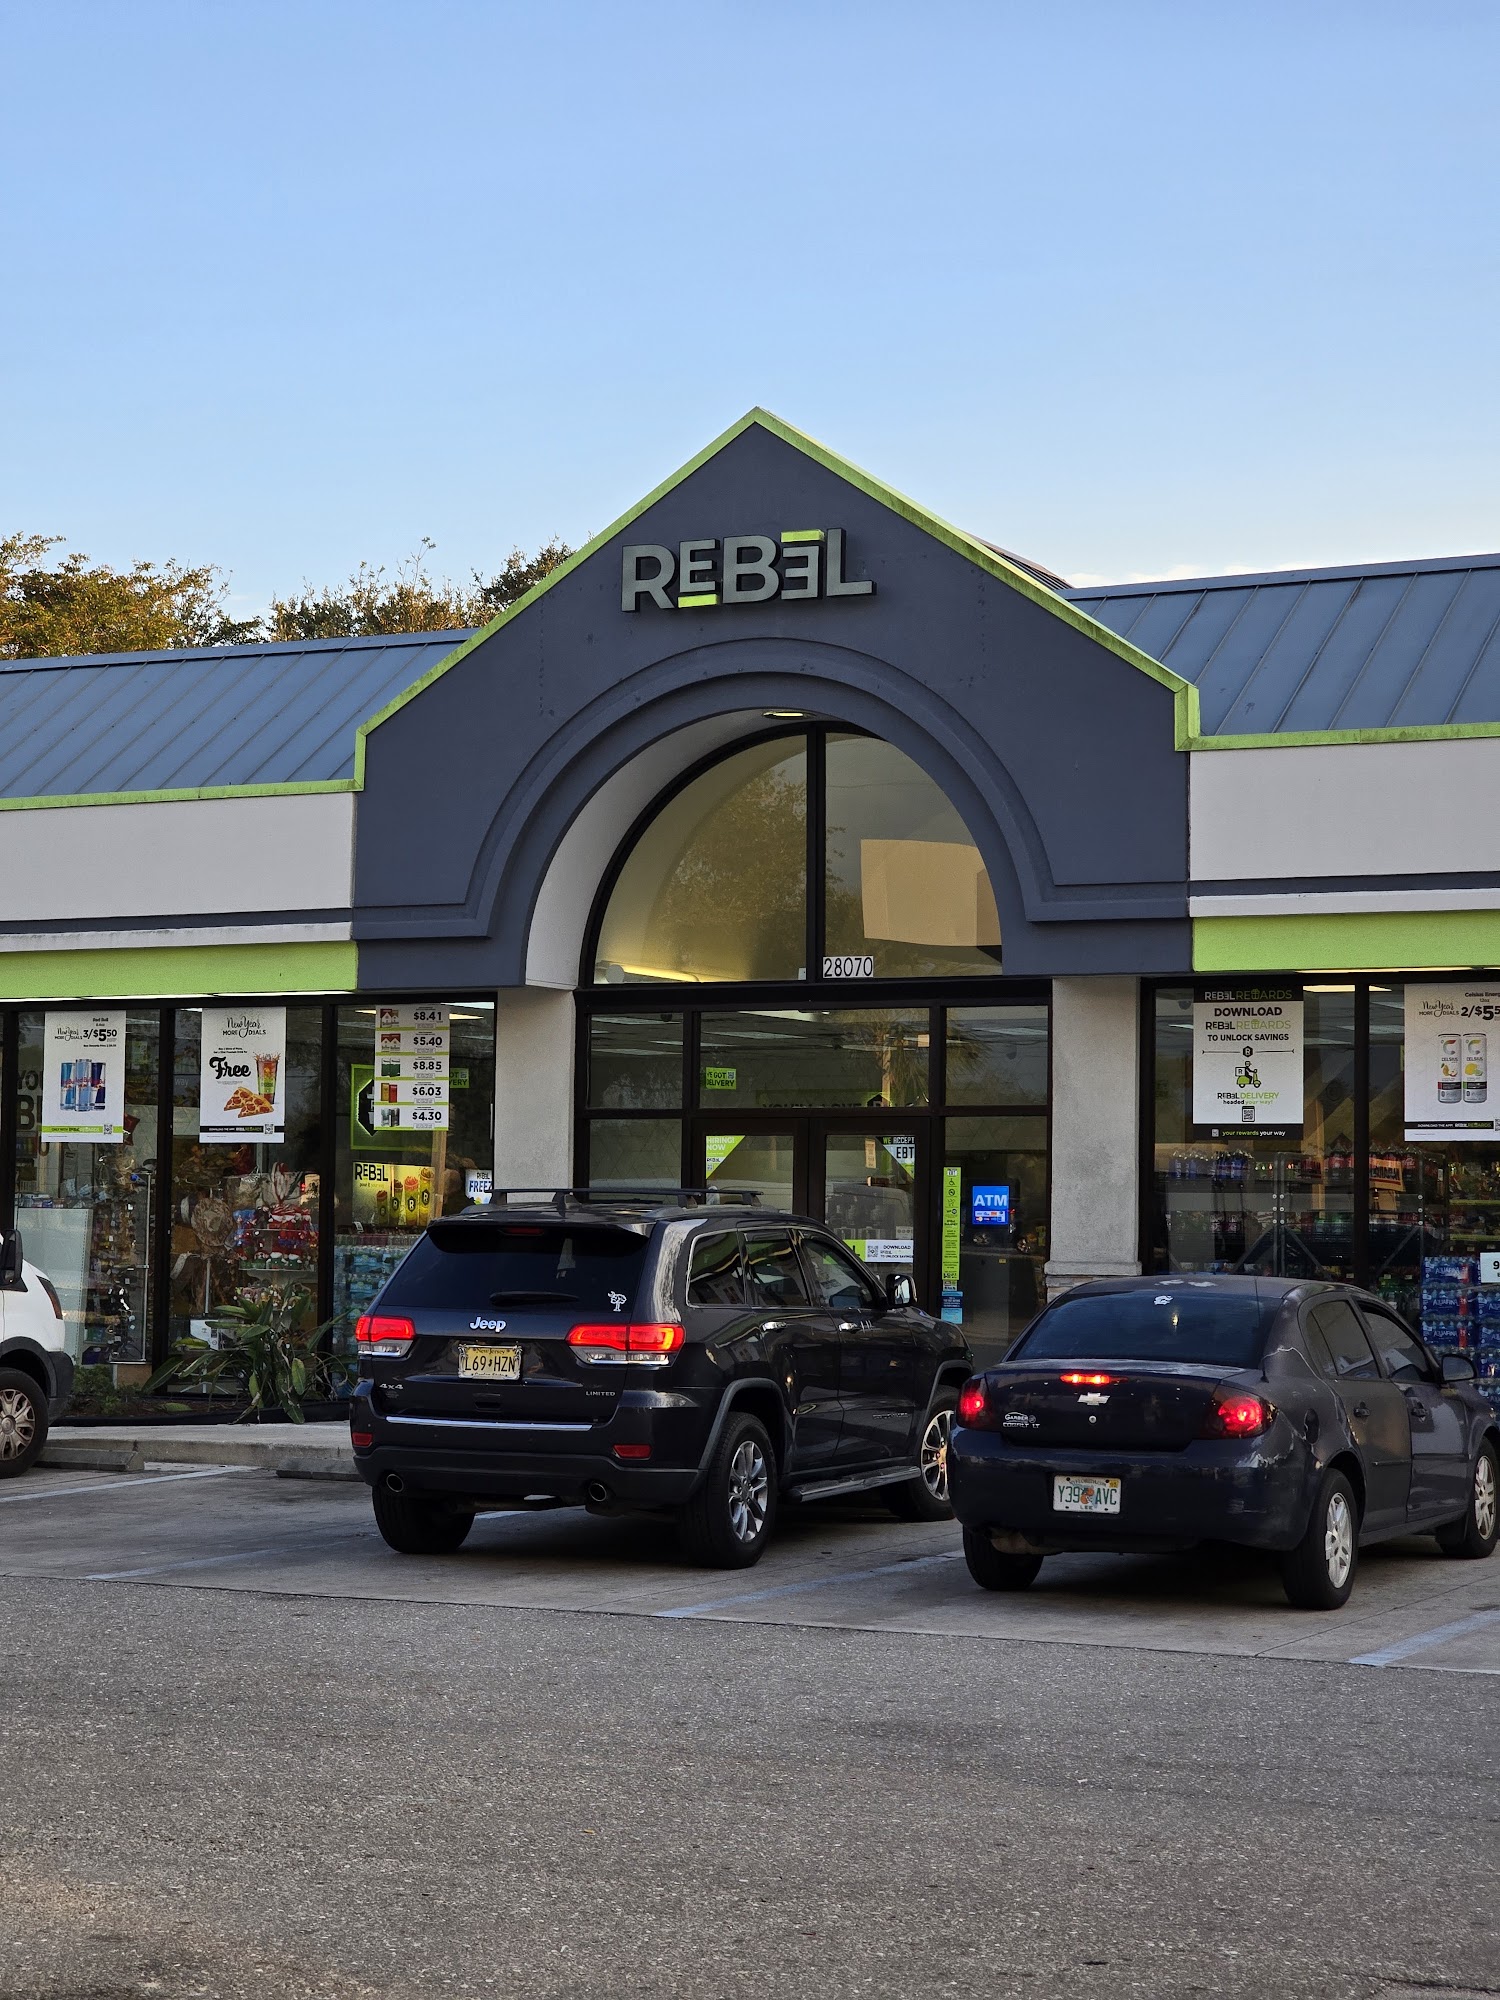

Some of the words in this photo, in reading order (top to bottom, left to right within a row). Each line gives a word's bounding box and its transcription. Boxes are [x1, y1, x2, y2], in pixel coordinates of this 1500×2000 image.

[621, 528, 875, 612] REBEL
[824, 957, 873, 977] 28070
[414, 1012, 441, 1020] $8.41
[1214, 1007, 1282, 1016] DOWNLOAD
[1206, 1021, 1235, 1030] REBEL
[413, 1037, 442, 1045] $5.40
[1254, 1033, 1289, 1041] SAVINGS
[209, 1056, 251, 1079] Free
[413, 1061, 442, 1070] $8.85
[412, 1087, 441, 1096] $6.03
[412, 1112, 442, 1121] $4.30
[897, 1147, 914, 1158] EBT
[355, 1163, 388, 1181] REBEL
[974, 1195, 1007, 1206] ATM
[470, 1317, 506, 1332] Jeep
